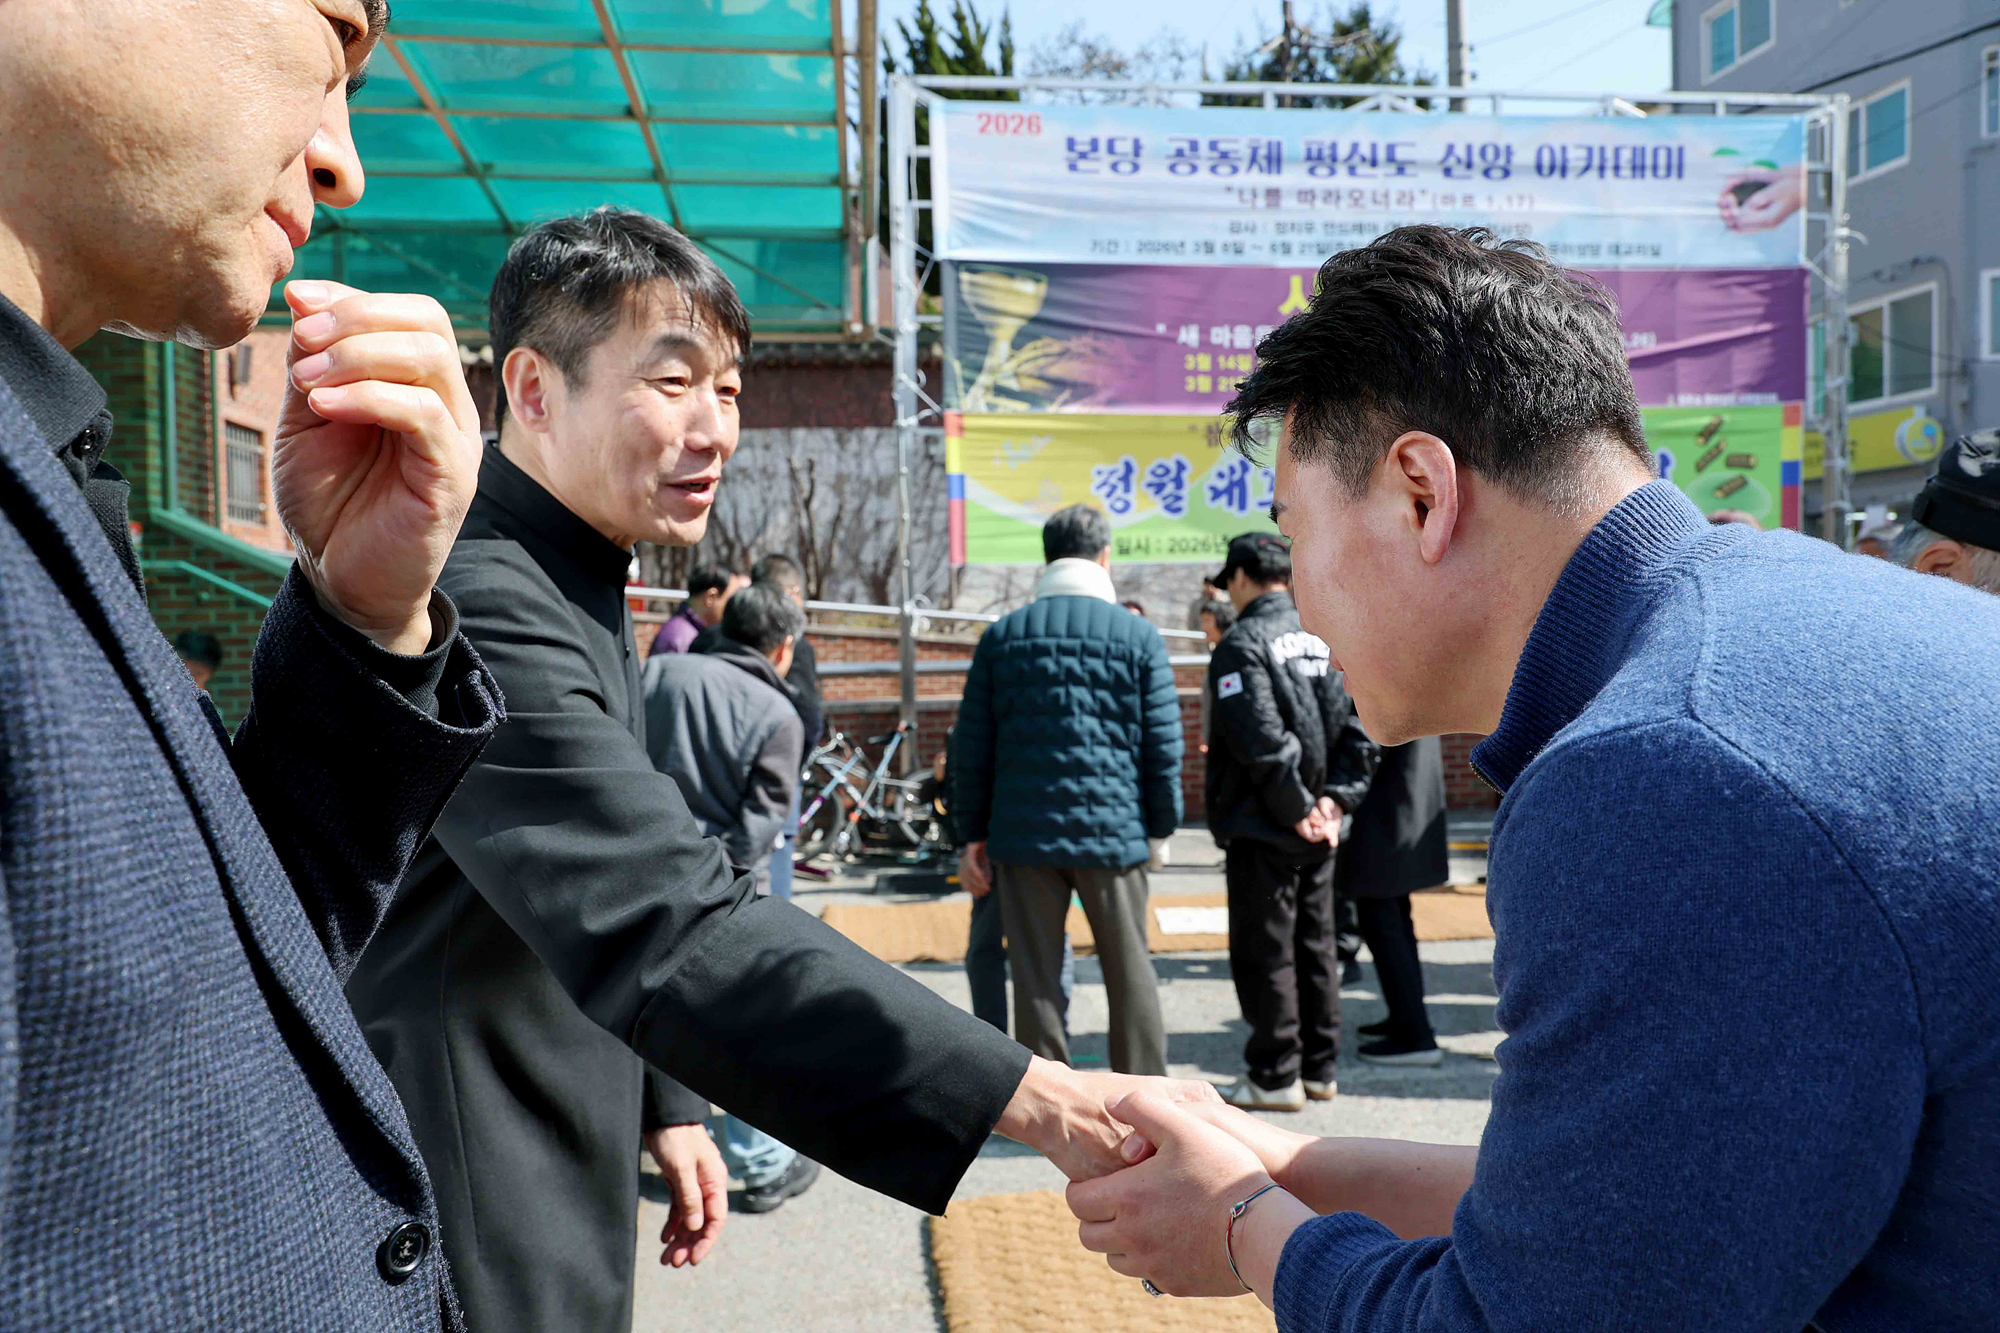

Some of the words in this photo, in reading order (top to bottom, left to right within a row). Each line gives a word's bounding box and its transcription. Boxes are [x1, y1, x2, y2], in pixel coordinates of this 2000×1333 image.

[977, 112, 1042, 135] 2026
[1065, 136, 1146, 176] 본당
[1165, 138, 1284, 177] 공동체
[1303, 140, 1418, 178] 평신도
[1438, 142, 1514, 181] 신앙
[1535, 143, 1686, 180] 아카데미
[1090, 239, 1119, 254] 기간
[1184, 353, 1212, 372] 3월
[1184, 374, 1212, 393] 3월
[1093, 458, 1189, 516] 정월
[1116, 535, 1149, 555] 일시
[1168, 535, 1229, 554] 2026년
